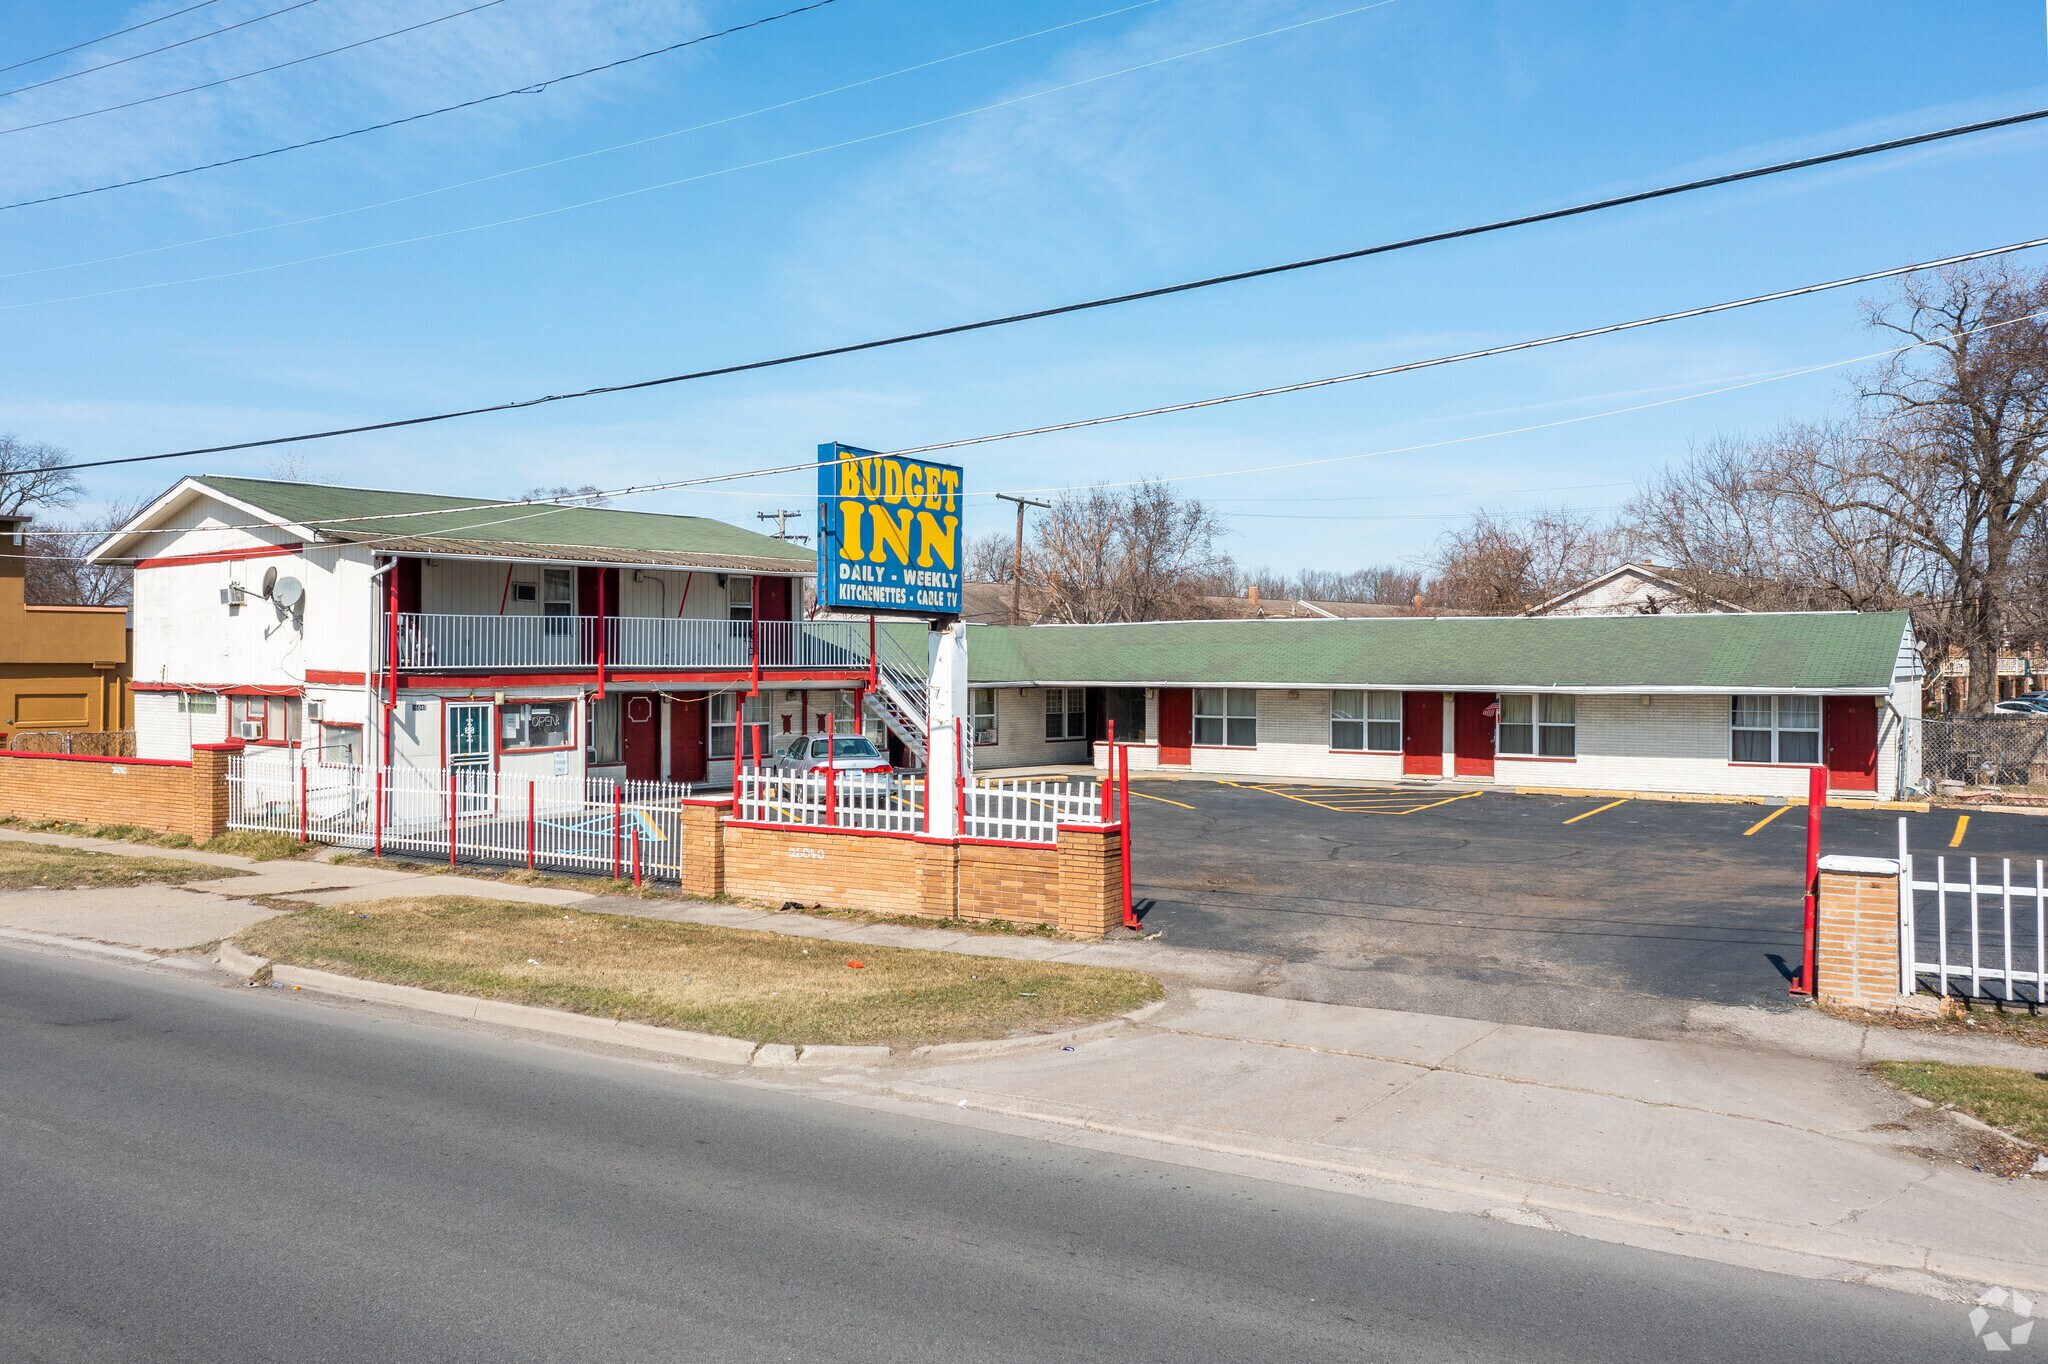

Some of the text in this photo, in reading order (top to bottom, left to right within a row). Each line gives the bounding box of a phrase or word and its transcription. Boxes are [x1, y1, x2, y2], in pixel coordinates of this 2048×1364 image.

[839, 451, 959, 512] BUDGET
[839, 500, 959, 570] INN
[839, 563, 885, 583] DAILY
[903, 569, 958, 589] WEEKLY
[839, 583, 907, 604] KITCHENETTES
[916, 590, 944, 607] CABLE
[946, 592, 958, 608] TV
[788, 847, 825, 859] 26040
